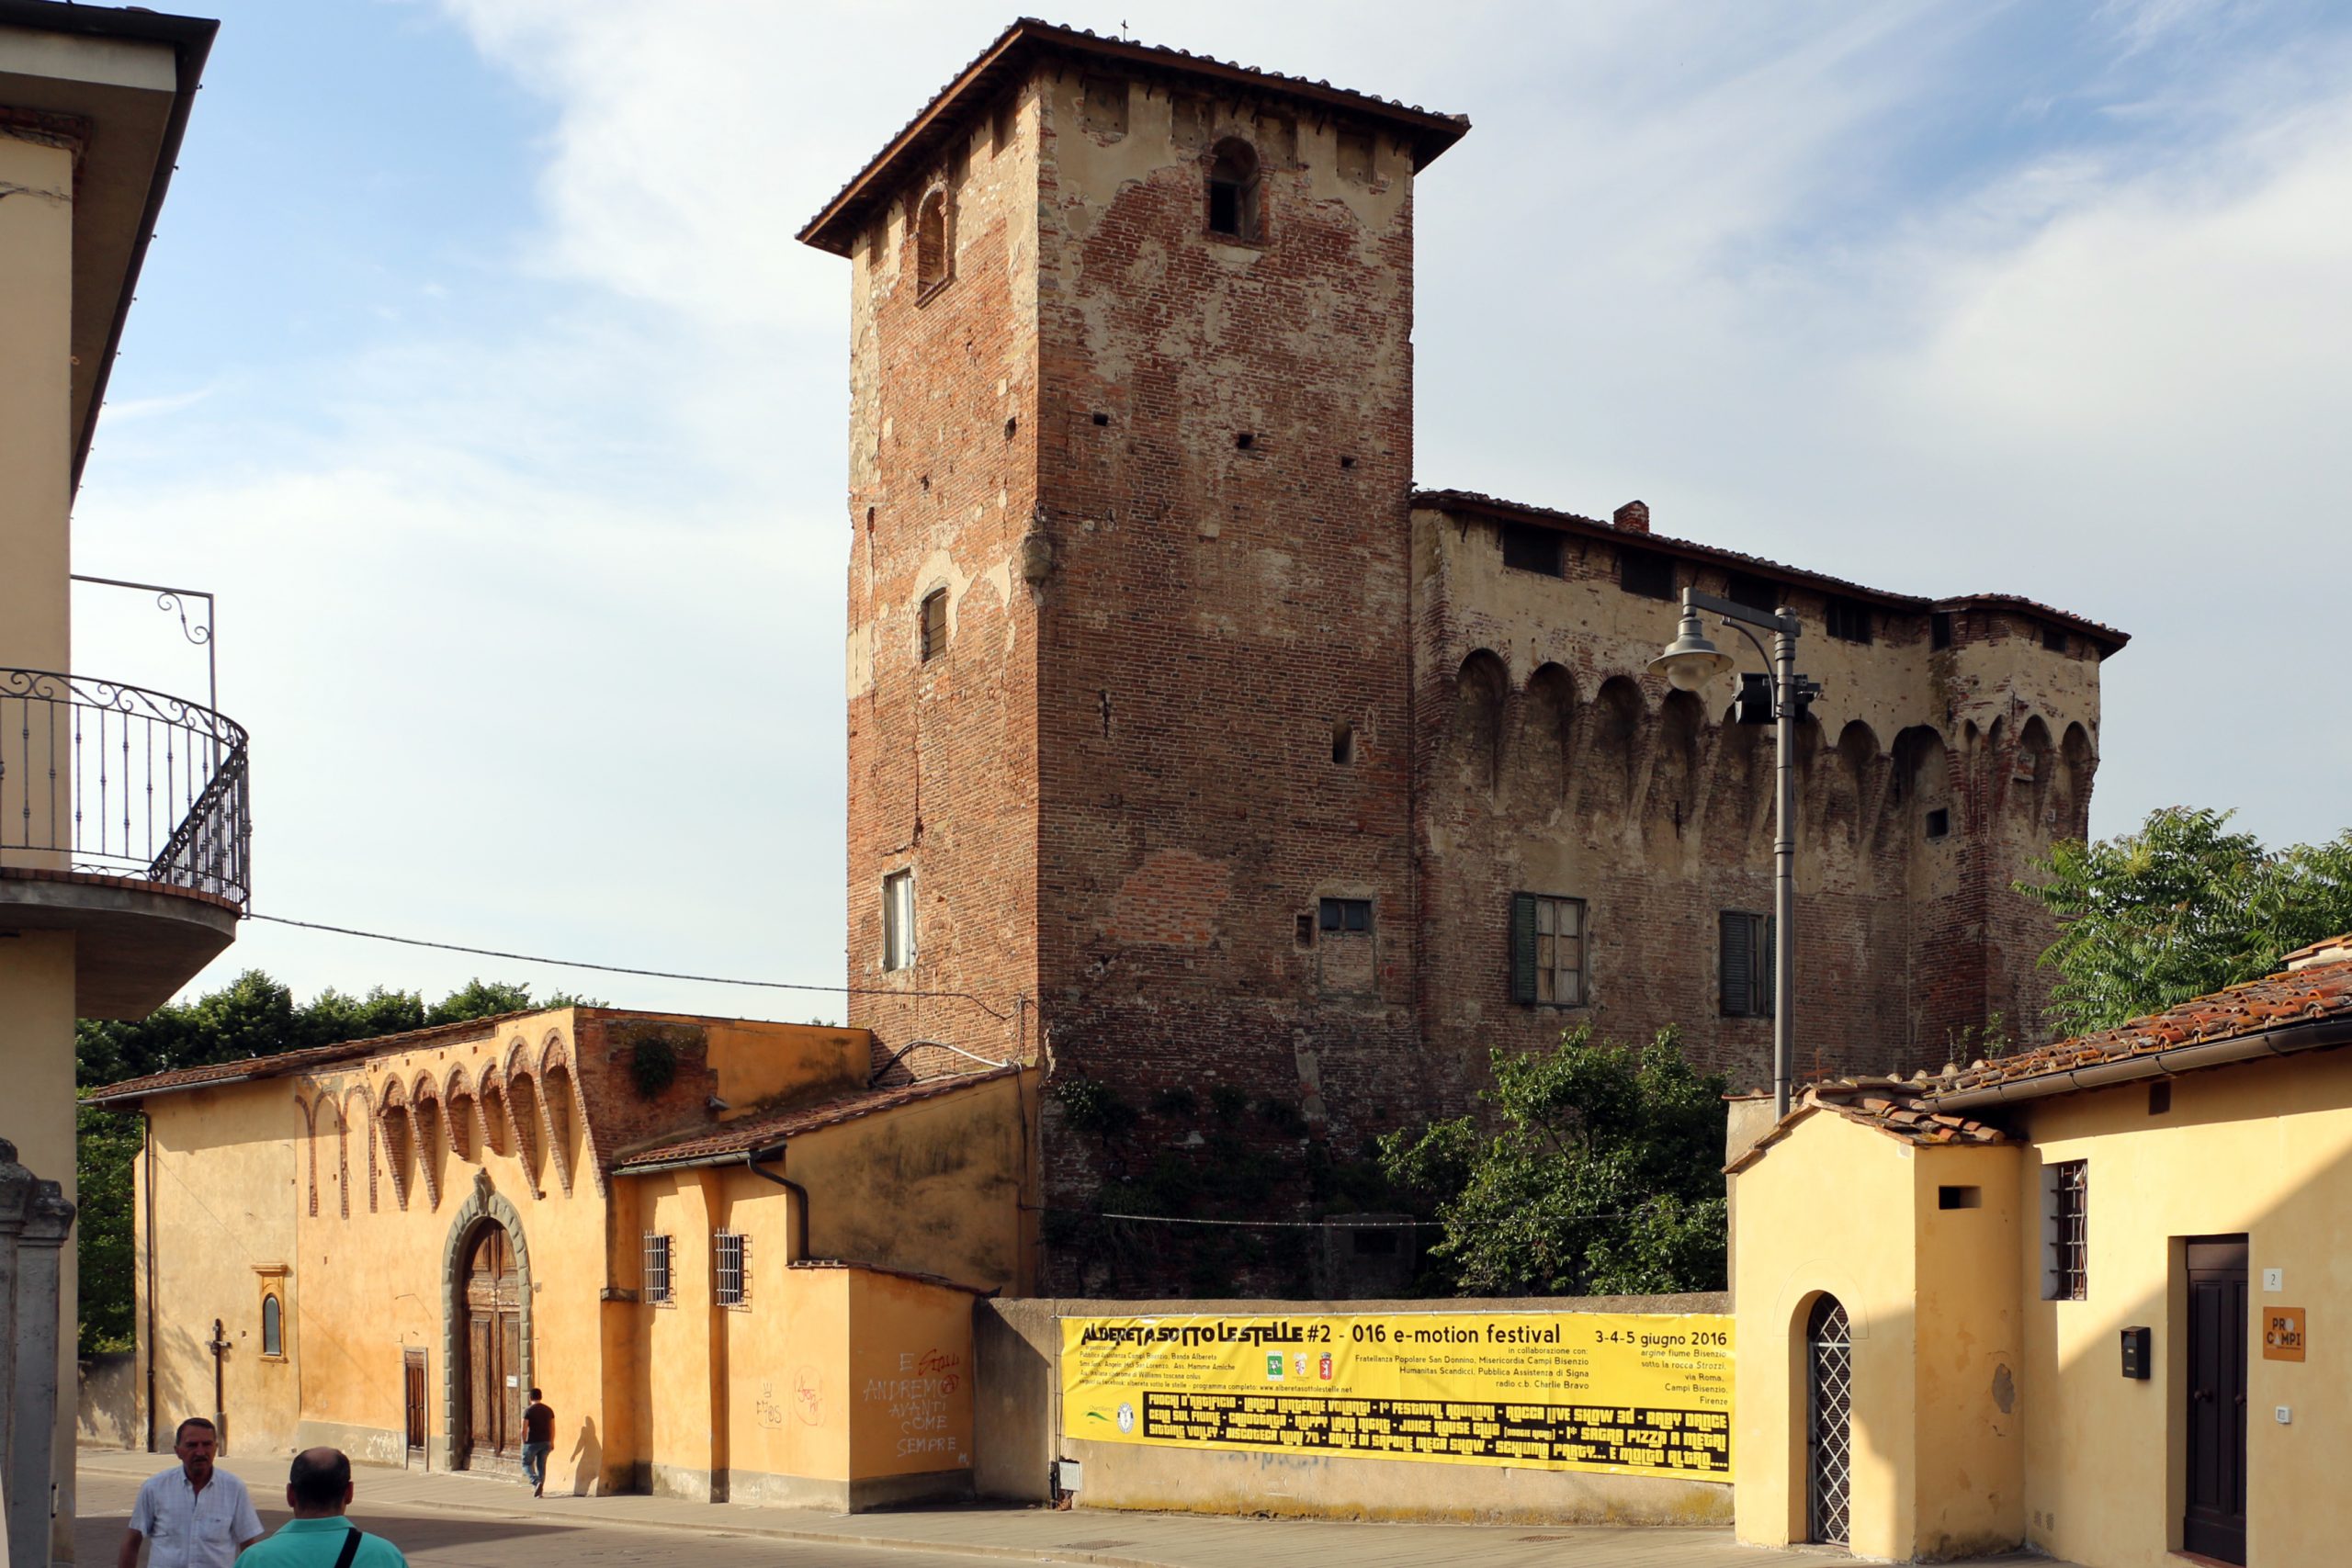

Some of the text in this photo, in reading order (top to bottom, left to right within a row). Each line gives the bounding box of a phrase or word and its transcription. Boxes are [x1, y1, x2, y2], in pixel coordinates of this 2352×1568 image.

[2270, 1273, 2276, 1286] 2
[2272, 1317, 2294, 1332] PRO
[1080, 1323, 1156, 1346] ALBERETA
[1157, 1326, 1215, 1347] SOTTO
[1217, 1322, 1238, 1342] LE
[1238, 1322, 1304, 1347] STELLE
[1306, 1325, 1331, 1343] #2
[1352, 1324, 1386, 1343] 016
[1394, 1325, 1478, 1343] e-motion
[1487, 1323, 1560, 1343] festival
[1595, 1330, 1727, 1348] 3-4-5 giugno 2016
[2267, 1331, 2301, 1346] CAMPI
[1517, 1347, 1570, 1355] collaborazione
[1641, 1349, 1726, 1359] argine fiume Bisenzio
[899, 1352, 915, 1371] E
[1395, 1355, 1427, 1364] Popolare
[1478, 1356, 1524, 1364] Misericordia
[1527, 1356, 1552, 1366] Campi
[1555, 1357, 1589, 1365] Bisenzio
[1662, 1360, 1669, 1369] la
[1478, 1368, 1510, 1376] Pubblica
[1513, 1368, 1554, 1377] Assistenza
[1566, 1369, 1589, 1379] Signa
[863, 1379, 950, 1402] ANDREMO
[1193, 1382, 1227, 1391] programma
[1227, 1382, 1258, 1392] completo:
[1496, 1380, 1515, 1388] radio
[1534, 1380, 1561, 1389] Charlie
[1564, 1381, 1589, 1390] Bravo
[1665, 1382, 1690, 1393] Campi
[1700, 1396, 1728, 1405] Firenze
[888, 1399, 946, 1419] AVANTI
[1148, 1393, 1180, 1409] FUOCHI
[1181, 1393, 1237, 1411] D'ARTIFICIO
[1244, 1397, 1276, 1413] LANCIO
[1277, 1398, 1326, 1415] LANTERNE
[1328, 1399, 1371, 1416] VOLANTI
[1392, 1402, 1443, 1420] FESTIVAL
[1445, 1404, 1496, 1422] AQUILONI
[1506, 1405, 1545, 1423] ROCCA
[1546, 1407, 1571, 1425] LIVE
[1574, 1408, 1614, 1427] SHOW
[1645, 1411, 1682, 1430] BABY
[1685, 1413, 1727, 1432] DANCE
[901, 1415, 947, 1434] COME
[1148, 1408, 1171, 1424] CENA
[1172, 1409, 1190, 1422] SUL
[1191, 1410, 1221, 1427] FIUME
[1330, 1416, 1356, 1433] LAND
[1358, 1417, 1391, 1434] NIGHT
[1399, 1418, 1431, 1433] JUICE
[1434, 1420, 1470, 1438] HOUSE
[1473, 1422, 1500, 1439] CLUB
[1580, 1427, 1624, 1446] SAGRA
[1627, 1429, 1668, 1449] PIZZA
[1670, 1431, 1680, 1445] A
[1683, 1432, 1726, 1452] METRI
[897, 1437, 956, 1458] SEMPRE
[1148, 1423, 1185, 1439] SITTING
[1186, 1425, 1218, 1440] VOLLEY
[1226, 1427, 1278, 1441] DISCOTECA
[1305, 1431, 1320, 1444] 70
[1329, 1432, 1356, 1448] BOLLE
[1359, 1433, 1369, 1447] DI
[1372, 1434, 1413, 1452] SAPONE
[1416, 1436, 1448, 1453] MEGA
[1450, 1438, 1486, 1455] SHOW
[1495, 1440, 1550, 1460] SCHIUMA
[1609, 1446, 1617, 1461] E
[1619, 1447, 1665, 1466] MOLTO
